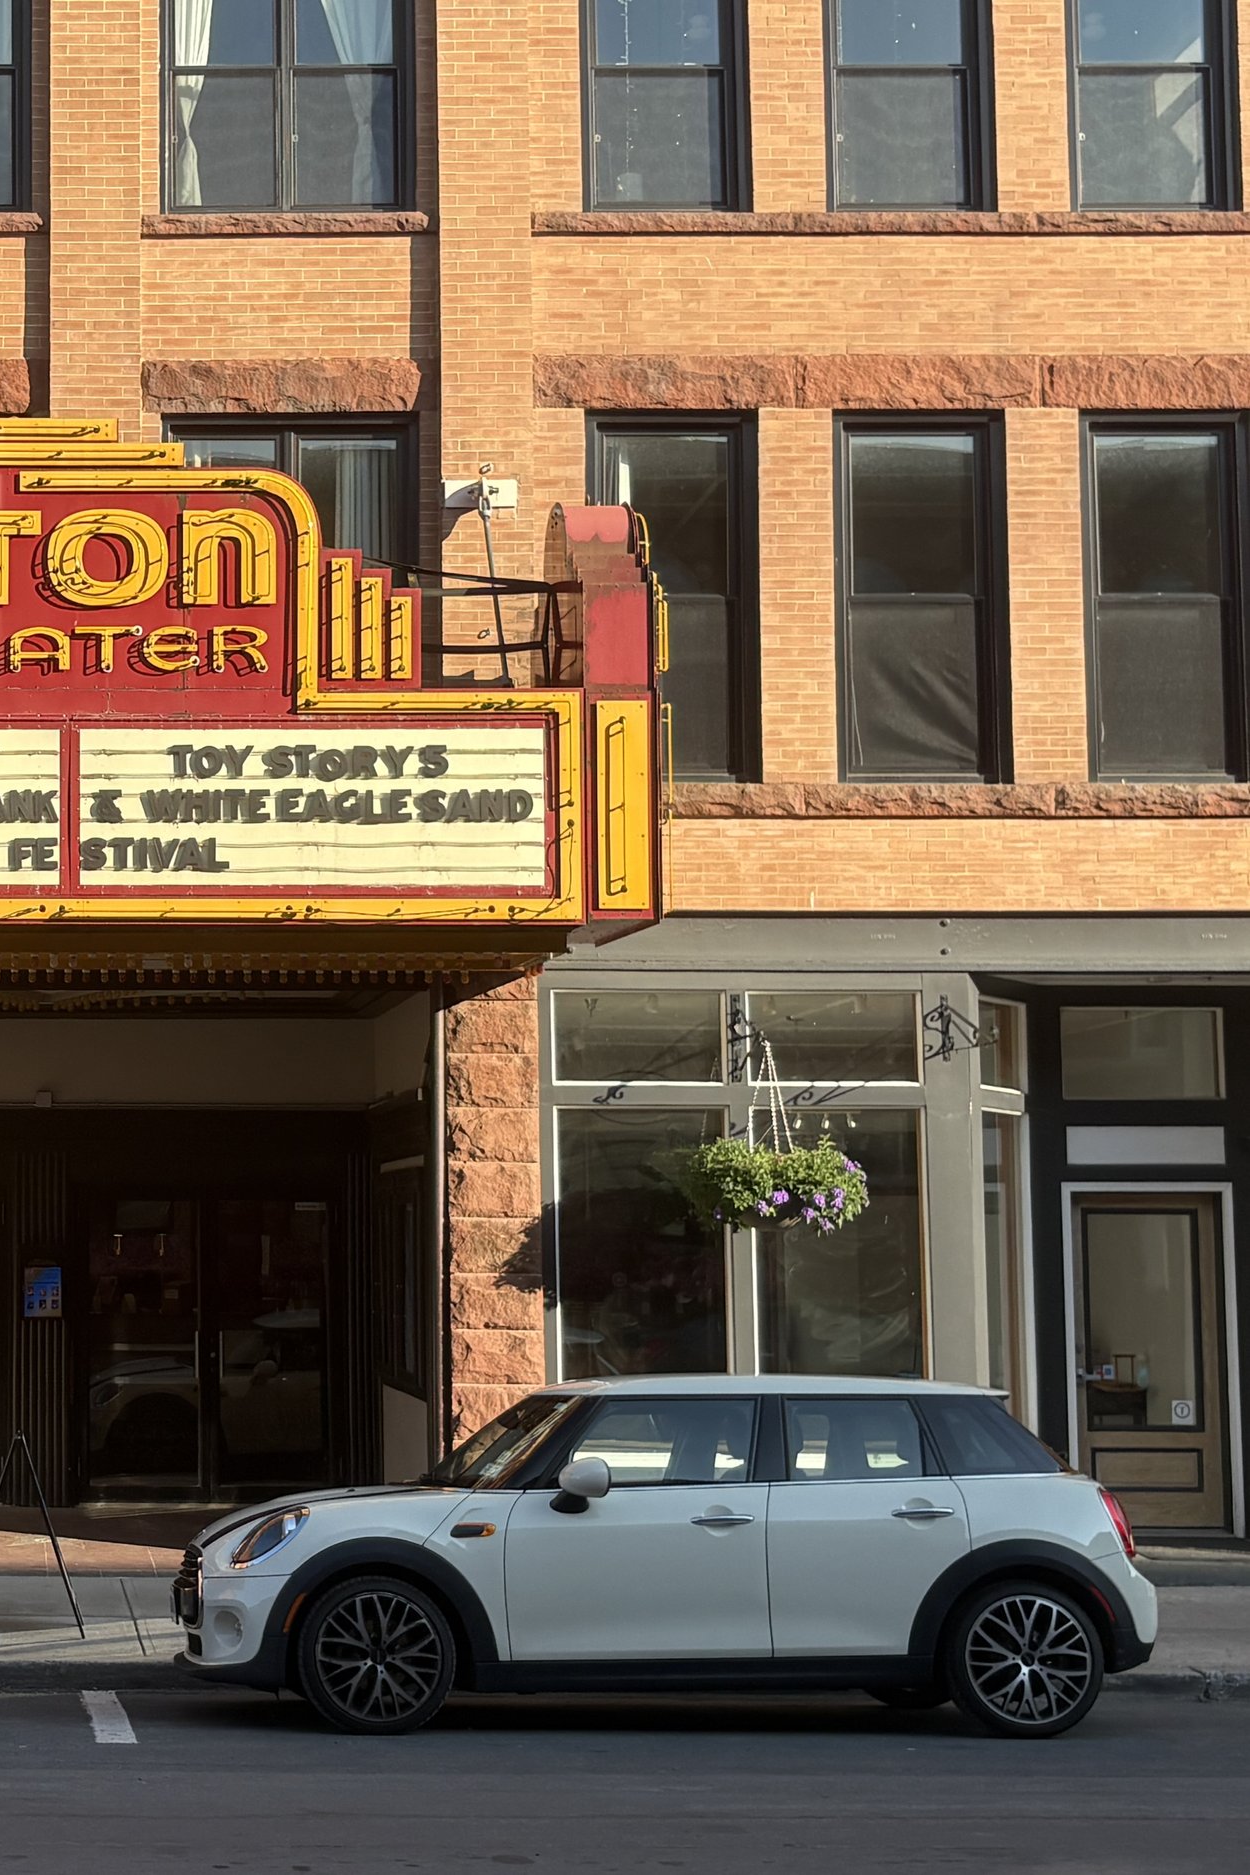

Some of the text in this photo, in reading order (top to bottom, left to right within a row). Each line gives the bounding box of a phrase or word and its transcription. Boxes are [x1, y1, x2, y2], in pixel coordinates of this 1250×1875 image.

[167, 744, 449, 782] TOY STORY 5
[90, 788, 534, 825] & WHITE EAGLE SAND
[8, 837, 59, 872] FE
[80, 837, 230, 873] STIVAL
